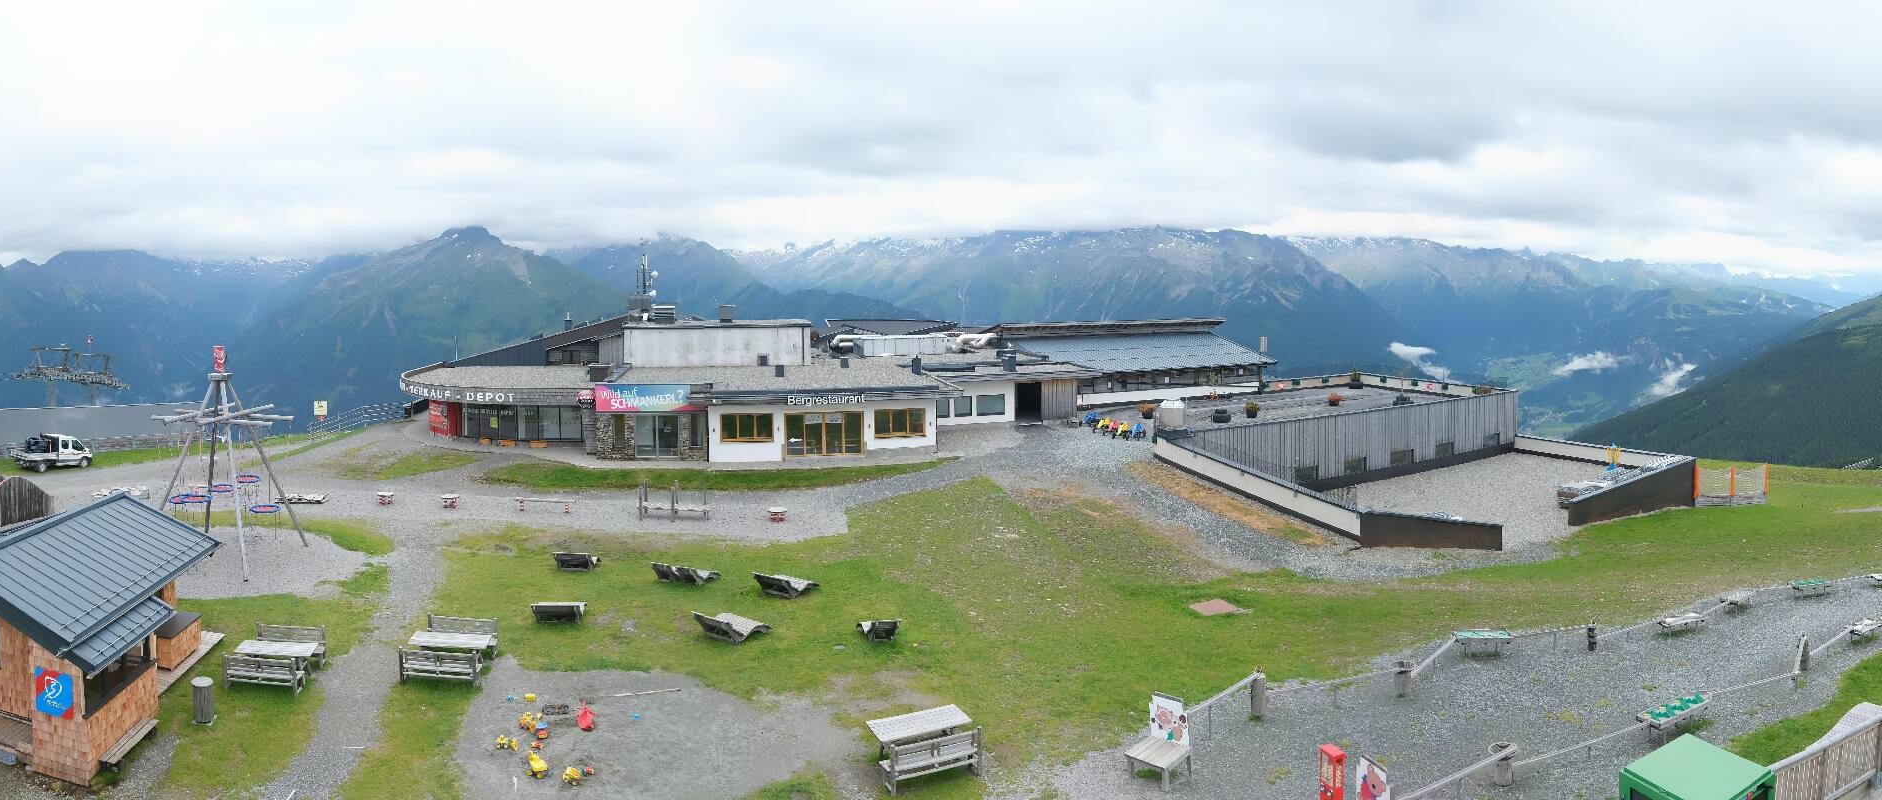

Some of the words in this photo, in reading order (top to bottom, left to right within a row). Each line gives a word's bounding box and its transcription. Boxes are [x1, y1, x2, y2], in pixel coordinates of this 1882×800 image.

[410, 386, 451, 400] VERKAUF
[466, 392, 515, 403] DEPOT
[600, 389, 621, 400] Wild
[623, 386, 637, 397] auf
[788, 394, 866, 406] Bergrestaurant
